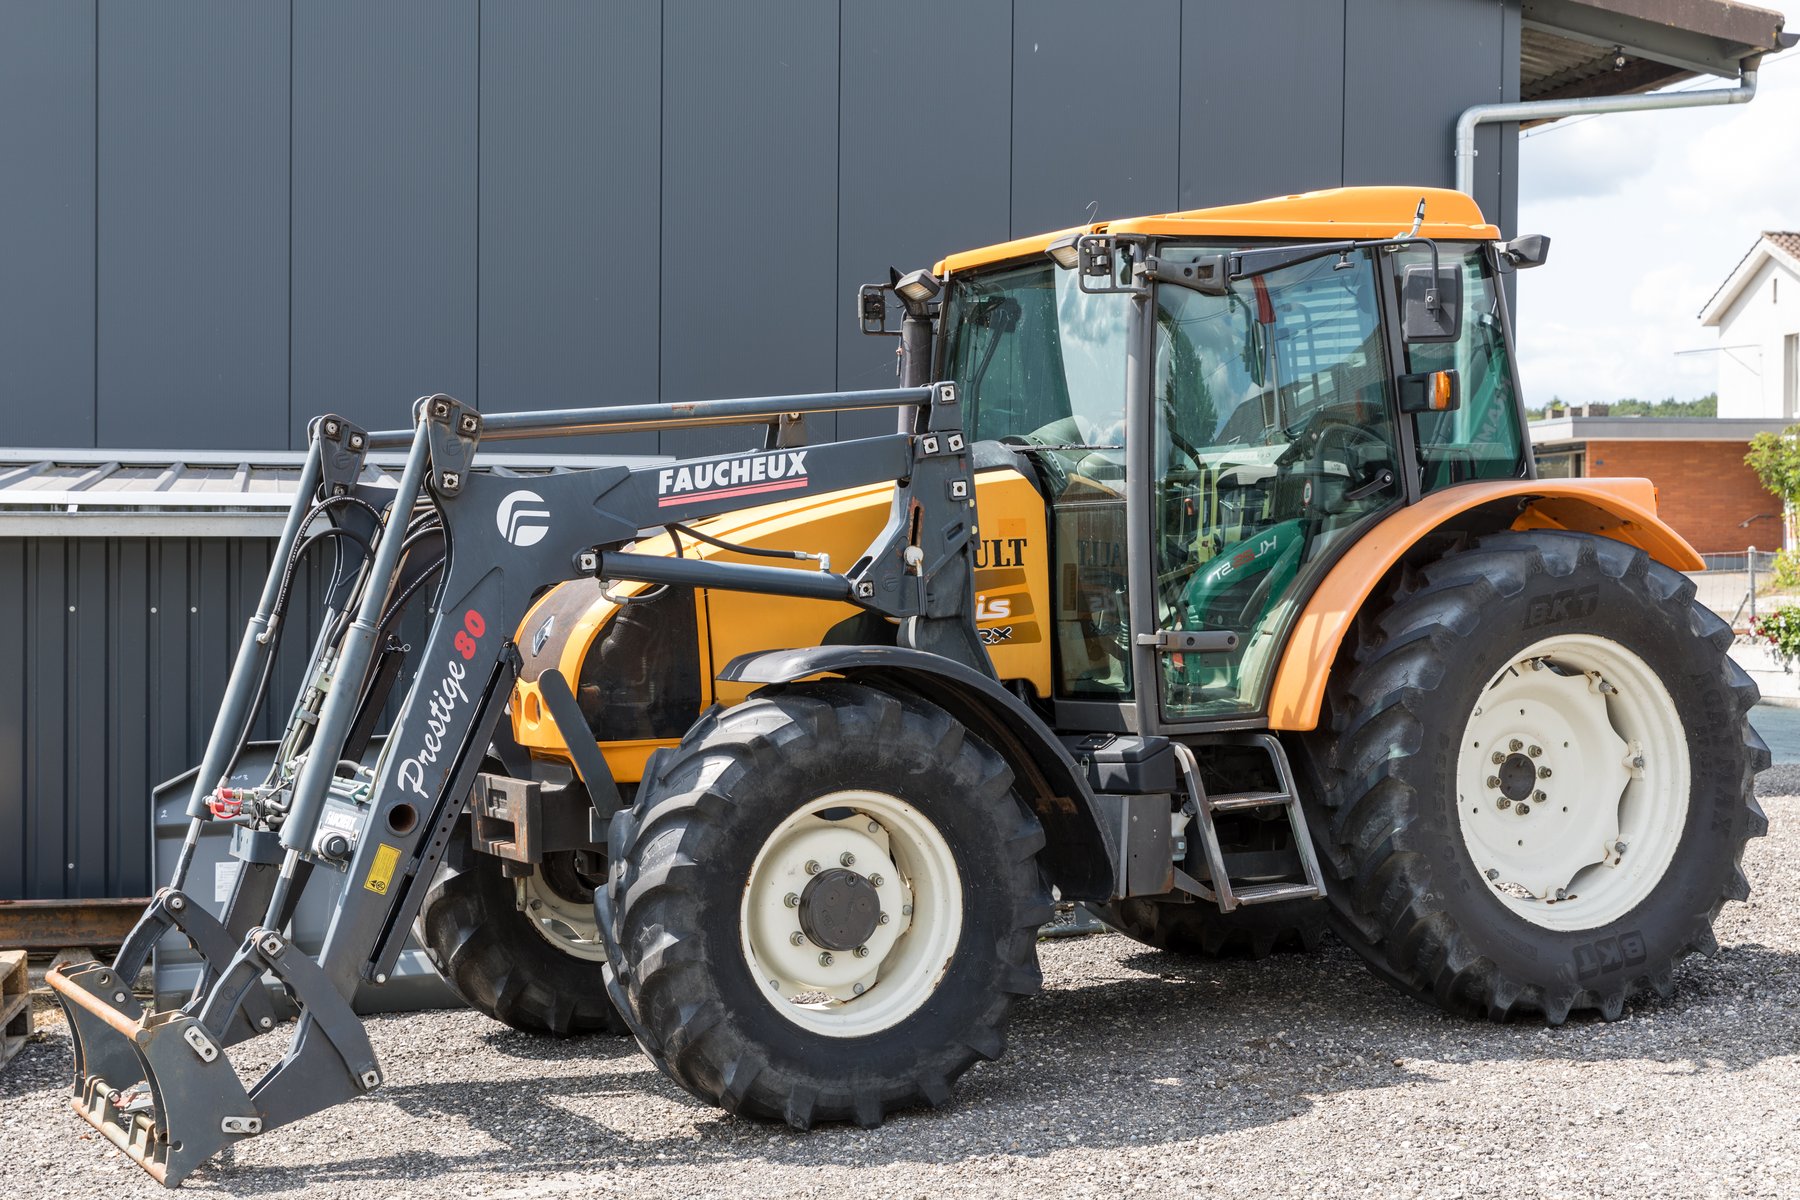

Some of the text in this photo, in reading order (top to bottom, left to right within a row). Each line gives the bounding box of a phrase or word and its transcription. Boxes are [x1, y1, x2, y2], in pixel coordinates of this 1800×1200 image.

[658, 450, 809, 495] FAUCHEUX
[1526, 586, 1600, 628] BKT
[397, 660, 469, 799] Prestige
[454, 609, 487, 661] 80
[1574, 930, 1647, 979] BKT
